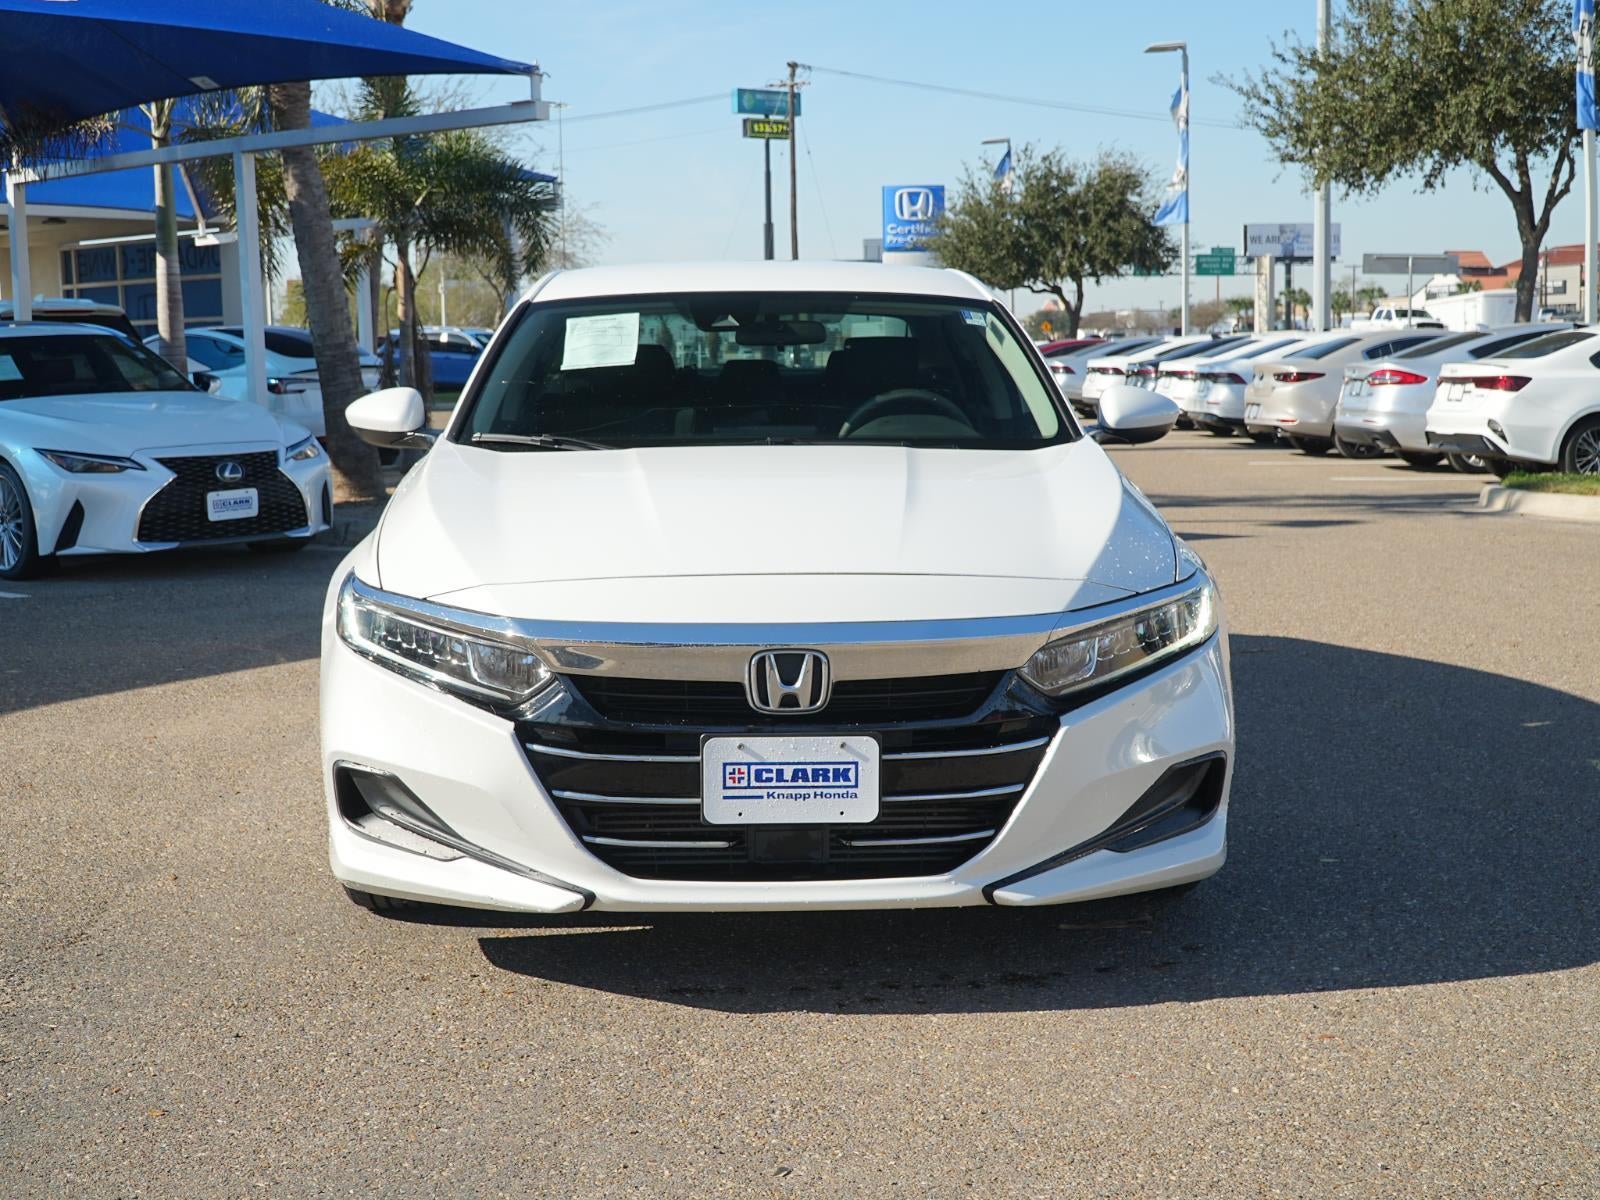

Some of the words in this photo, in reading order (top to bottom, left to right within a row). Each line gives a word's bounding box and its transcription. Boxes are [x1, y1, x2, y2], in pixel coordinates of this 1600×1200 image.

[887, 223, 936, 235] Certifi
[754, 767, 852, 783] CLARK
[766, 791, 811, 801] Knapp
[813, 790, 858, 800] Honda
